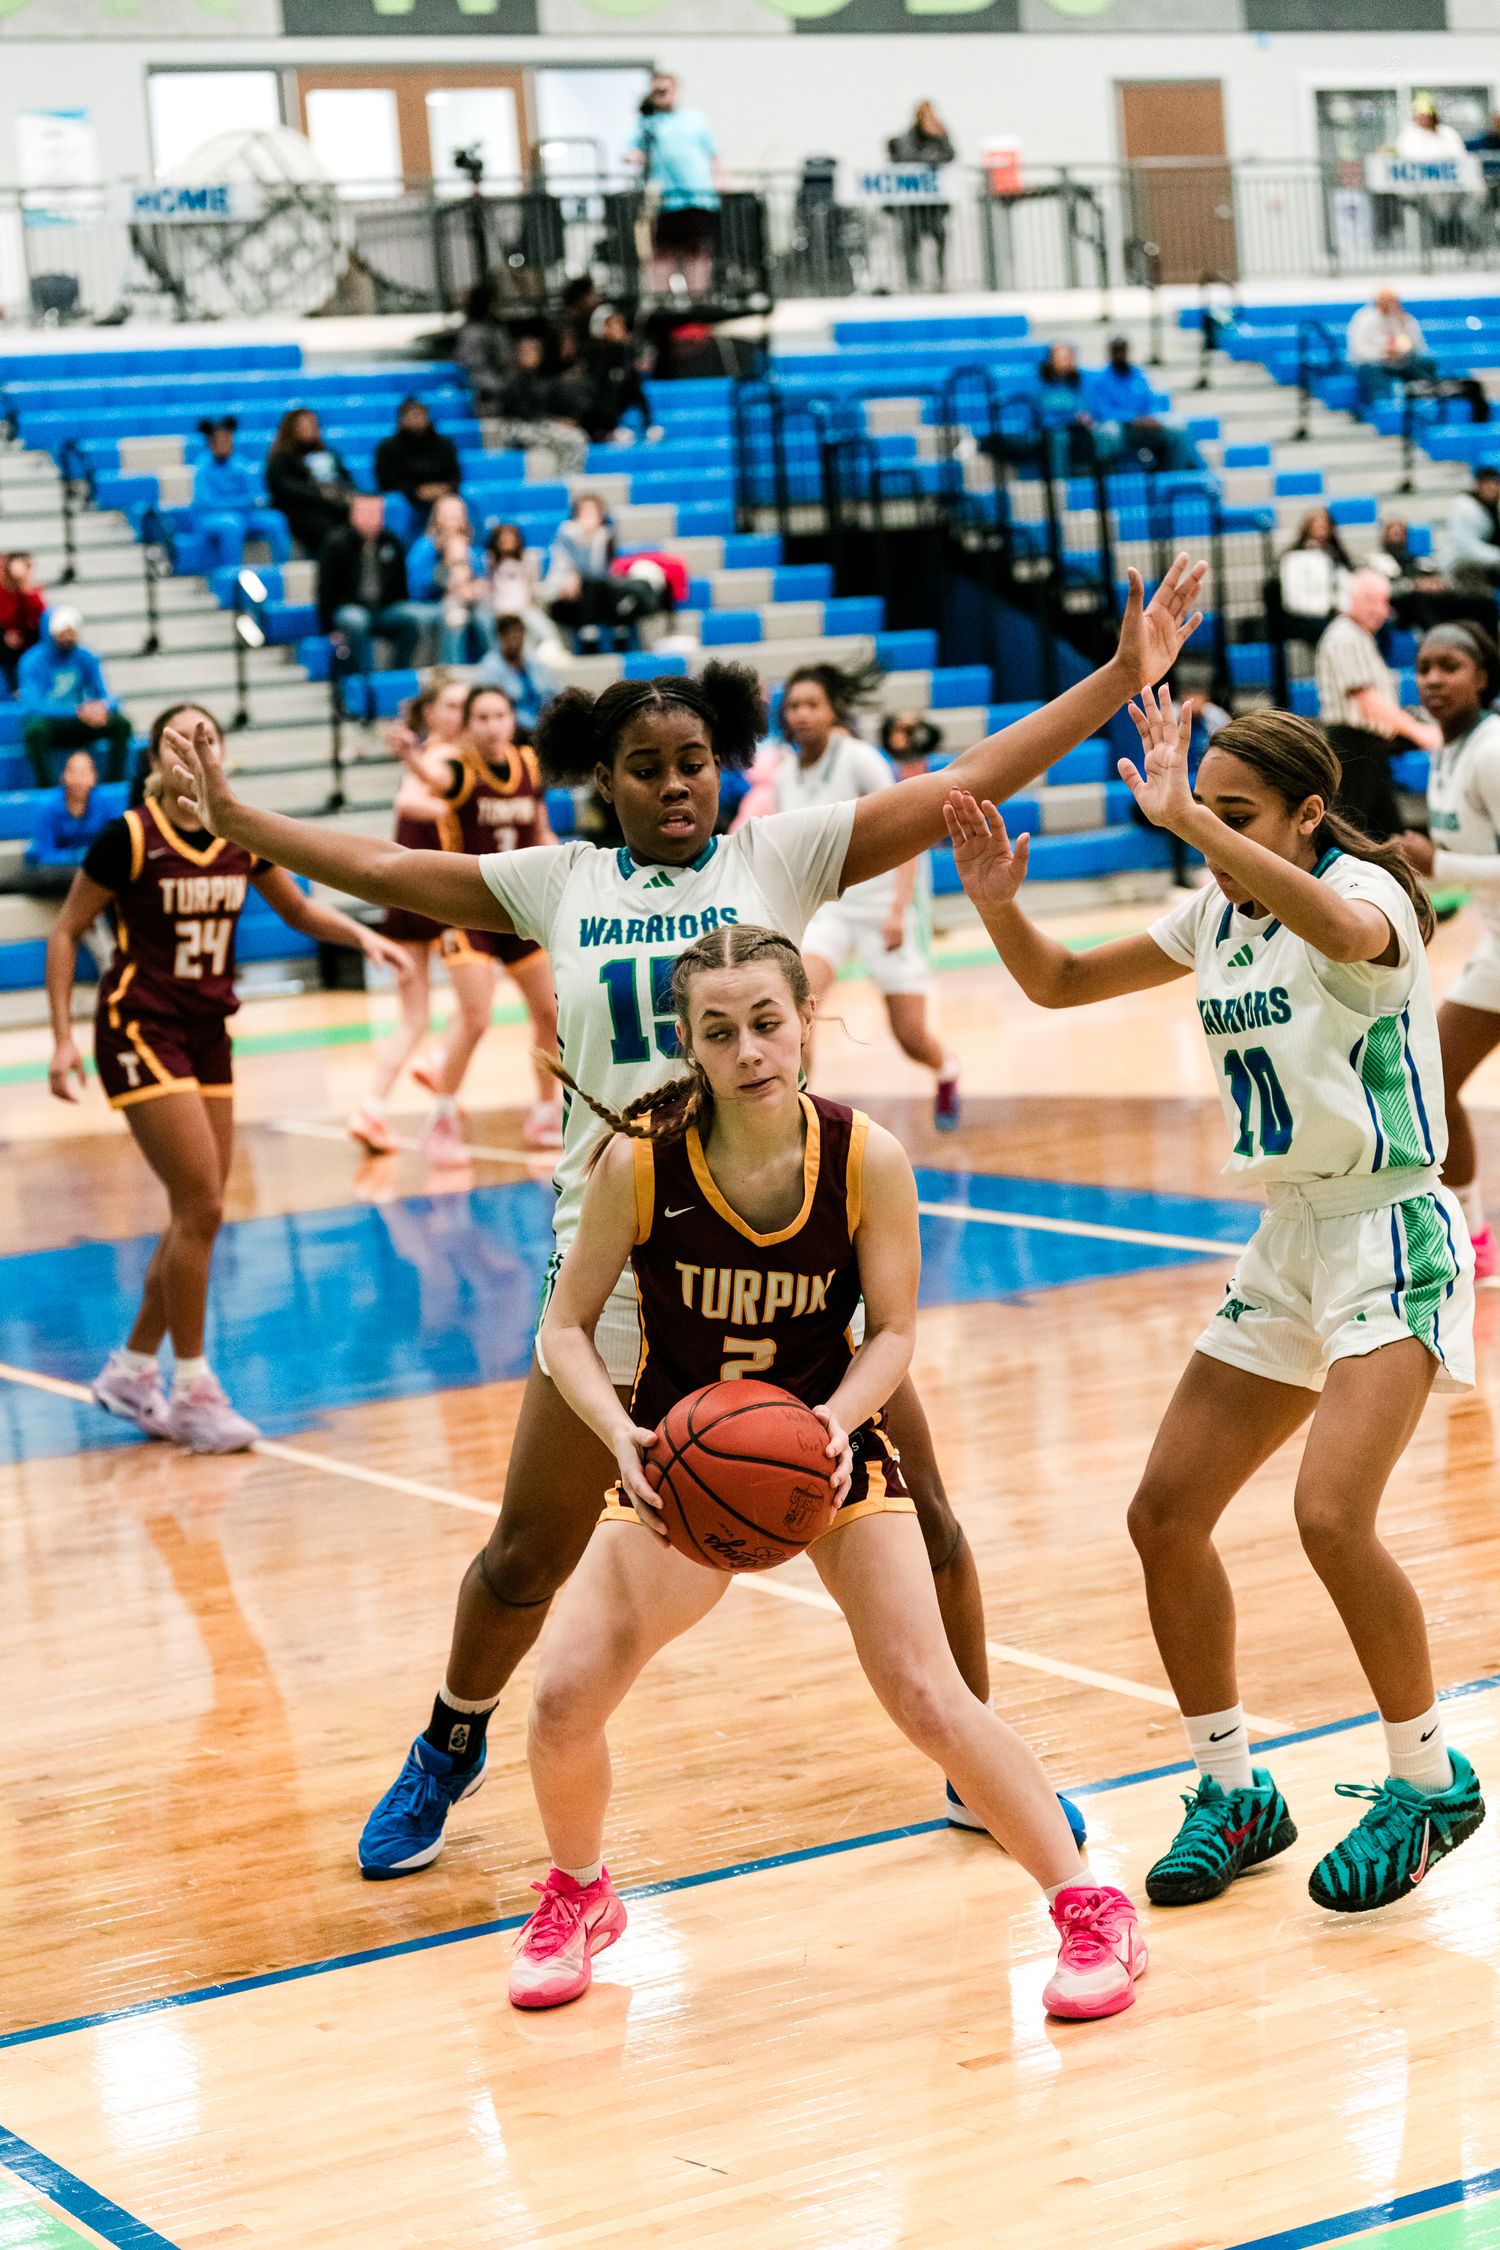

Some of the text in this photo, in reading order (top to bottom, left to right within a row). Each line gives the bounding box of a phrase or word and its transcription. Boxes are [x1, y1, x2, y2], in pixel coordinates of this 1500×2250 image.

[158, 874, 248, 915] TURPIN
[174, 917, 233, 980] 24
[579, 905, 739, 948] WARRIORS
[116, 1051, 142, 1088] T
[1223, 1046, 1294, 1158] 10
[674, 1259, 837, 1326] TURPIN
